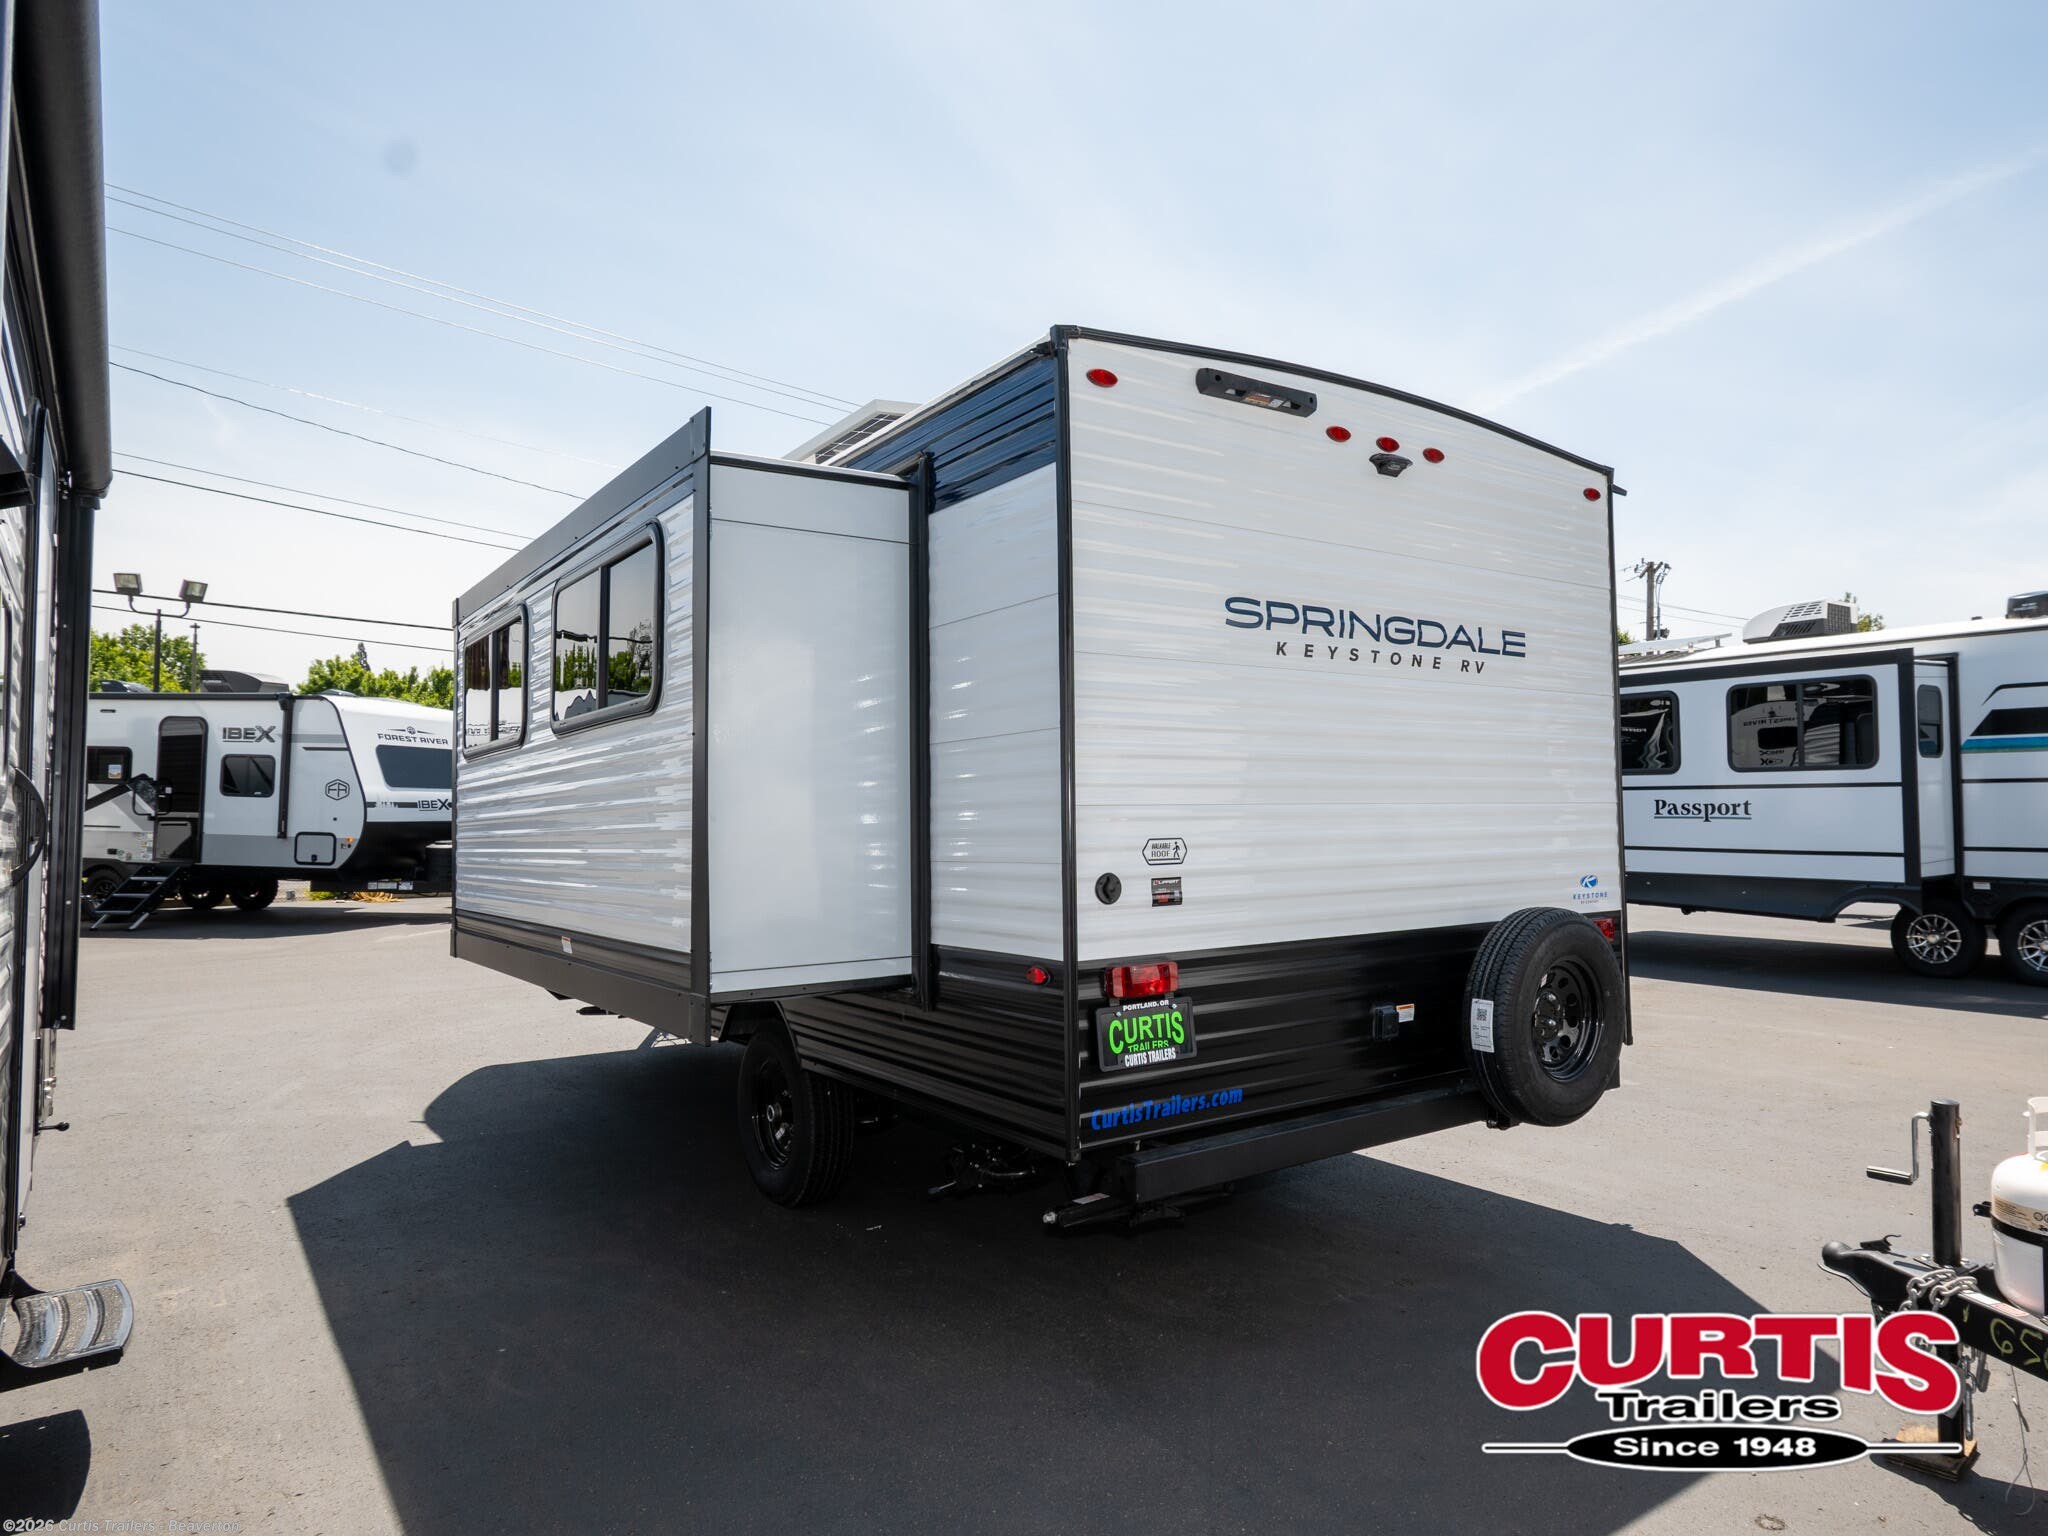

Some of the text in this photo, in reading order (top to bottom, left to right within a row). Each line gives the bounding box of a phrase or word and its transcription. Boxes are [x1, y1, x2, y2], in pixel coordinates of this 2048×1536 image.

[1225, 596, 1526, 658] SPRINGDALE
[1276, 641, 1485, 674] KEYSTONE RV
[222, 725, 276, 743] IBEX
[377, 733, 449, 745] FOREST RIVER
[417, 798, 449, 811] IBEX
[1654, 799, 1752, 822] Passport
[1109, 1011, 1185, 1055] CURTIS
[1124, 1047, 1176, 1067] CURTIS TRAILERS
[1091, 1088, 1243, 1130] CurtisTrailers.com
